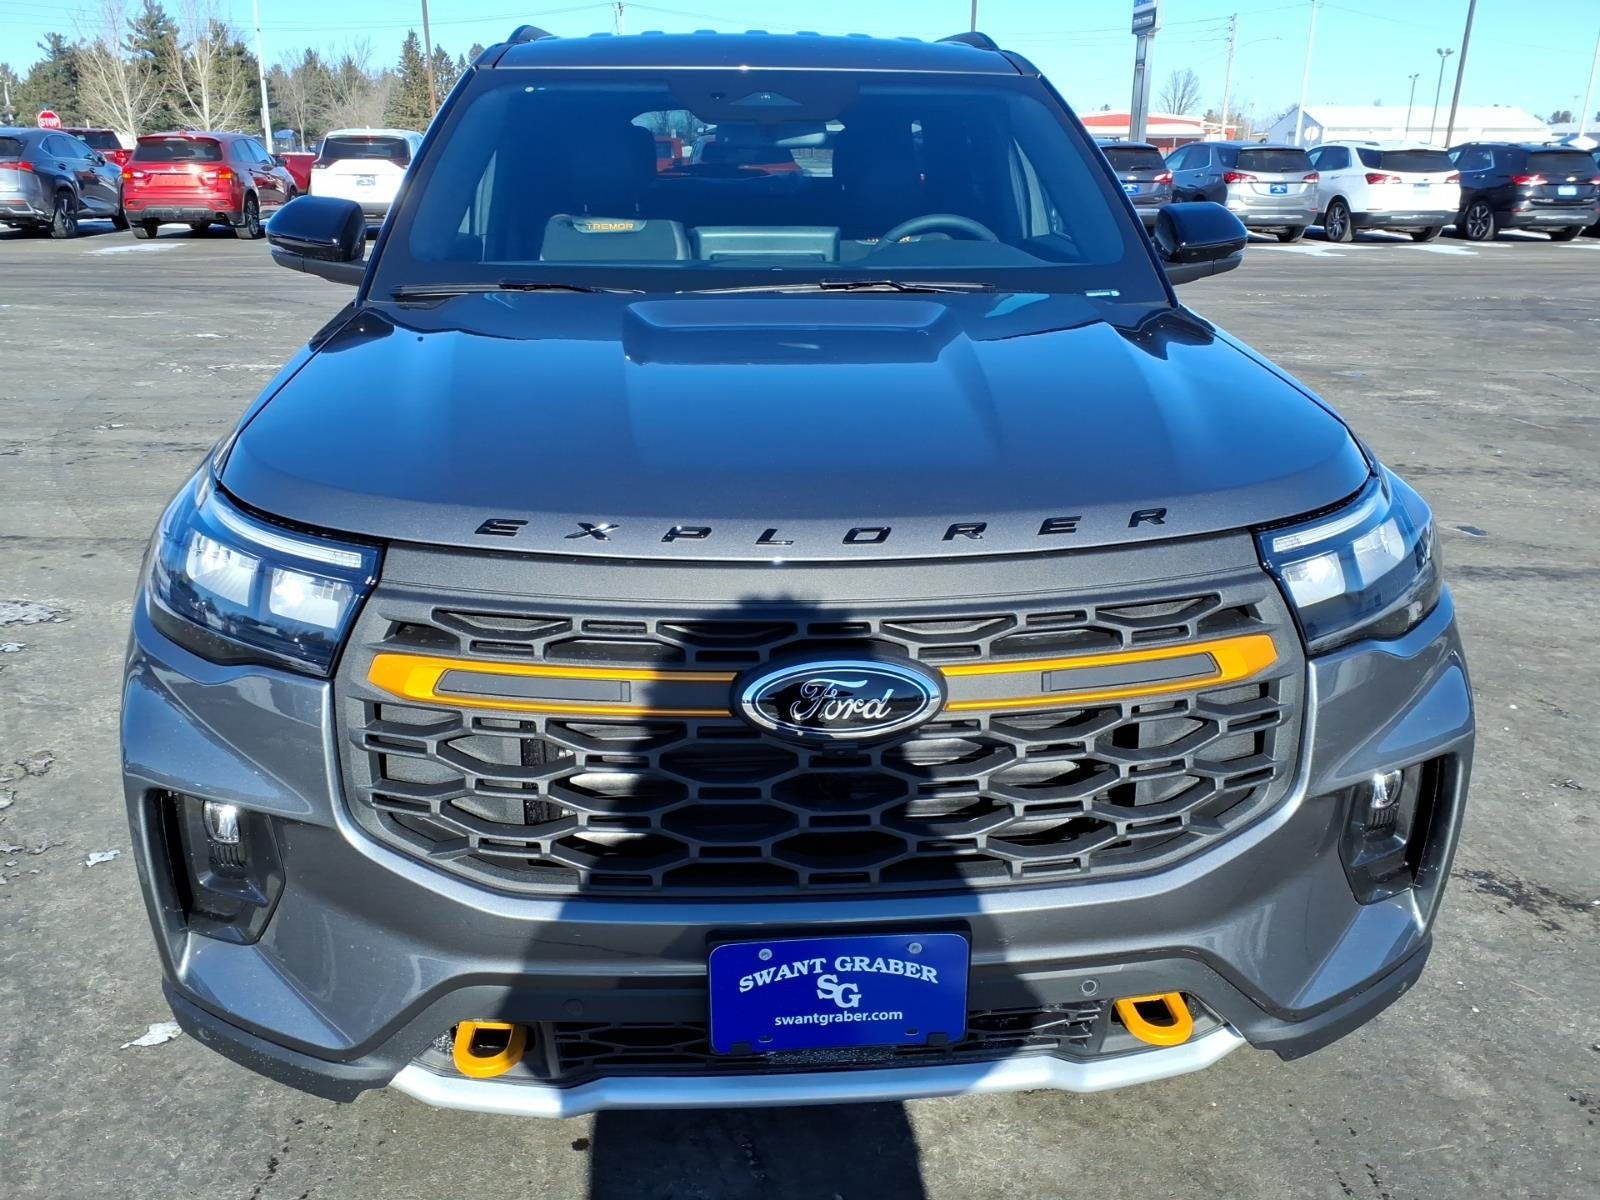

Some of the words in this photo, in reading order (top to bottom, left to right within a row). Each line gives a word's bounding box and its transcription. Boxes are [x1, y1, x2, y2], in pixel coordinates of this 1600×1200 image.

[40, 117, 60, 128] STOP
[585, 223, 635, 231] TREMOR
[474, 507, 1168, 545] EXPLORER
[789, 677, 895, 721] Ford
[738, 957, 827, 993] SWANT
[834, 956, 939, 984] GRABER
[816, 974, 862, 1008] SG
[774, 1010, 903, 1026] swantgraber.com
